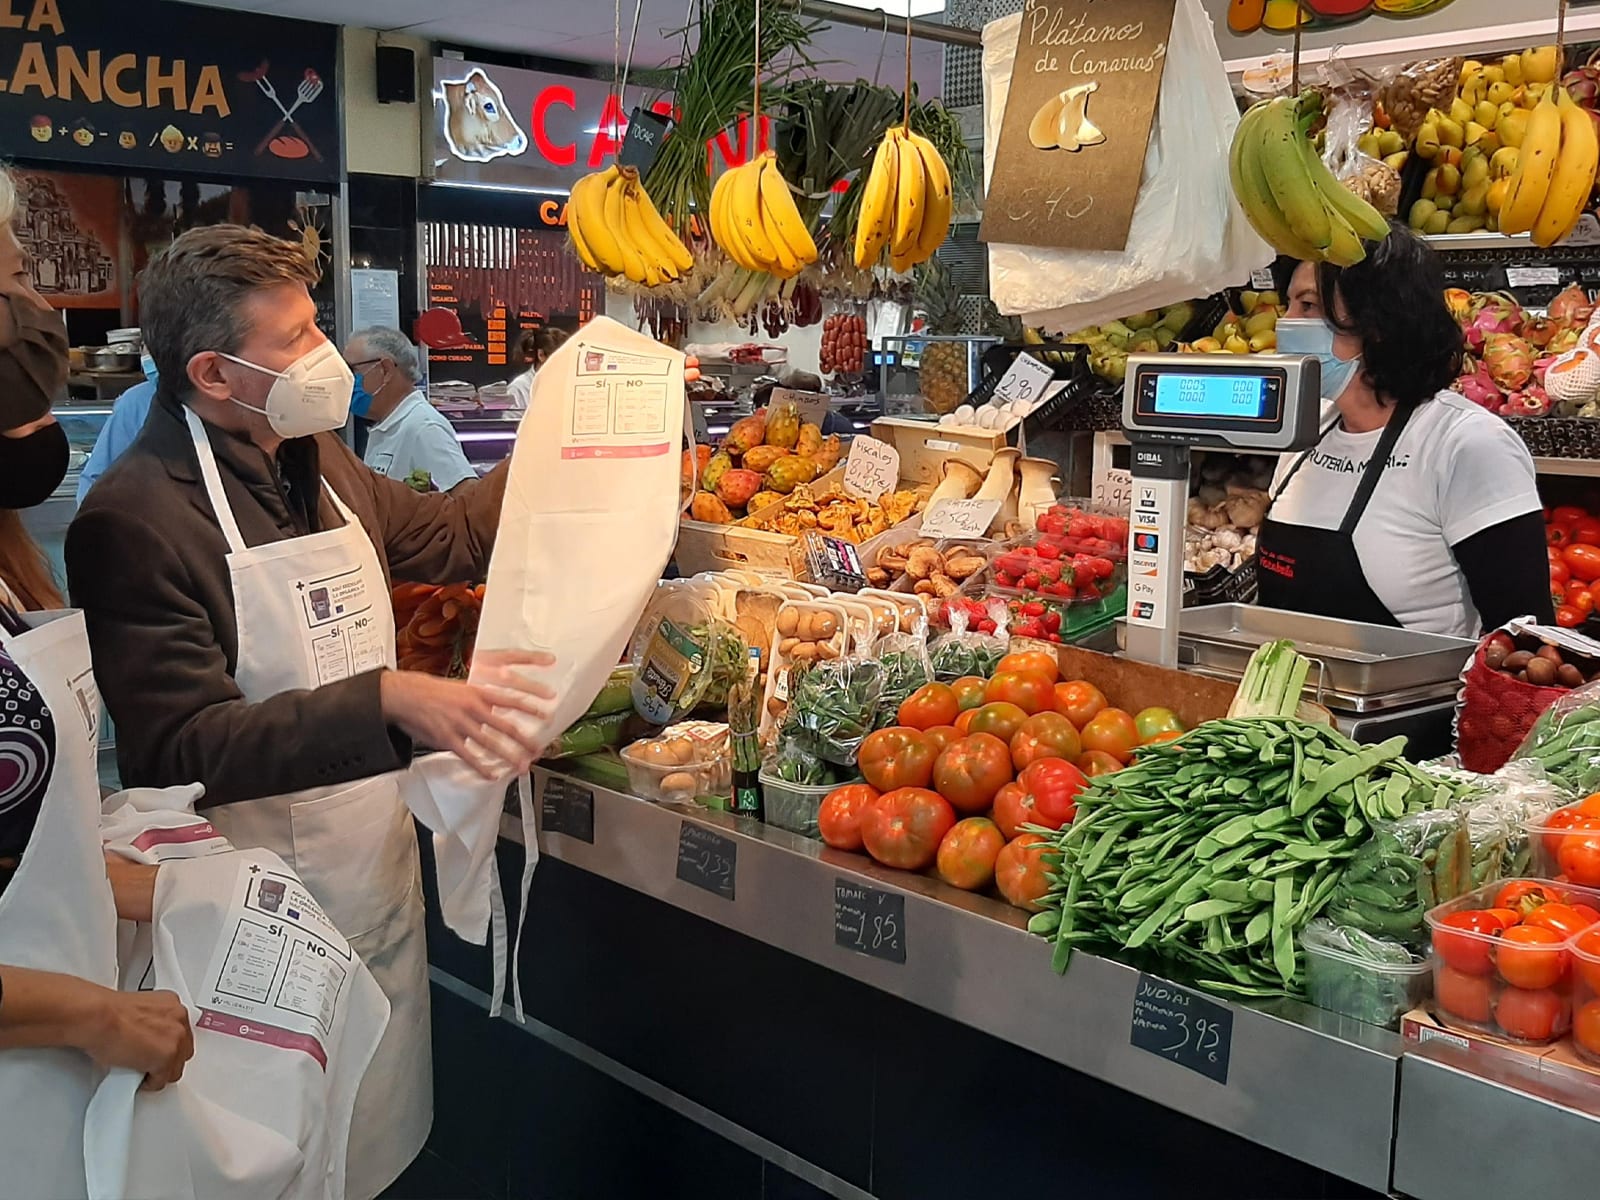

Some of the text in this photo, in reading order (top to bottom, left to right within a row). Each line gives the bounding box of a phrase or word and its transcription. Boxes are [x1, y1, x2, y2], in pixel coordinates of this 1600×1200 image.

[1035, 50, 1058, 73] de
[0, 41, 231, 118] ANCHA
[625, 379, 644, 388] NO
[1138, 514, 1157, 525] VISA
[354, 620, 369, 631] NO
[306, 940, 327, 958] NO
